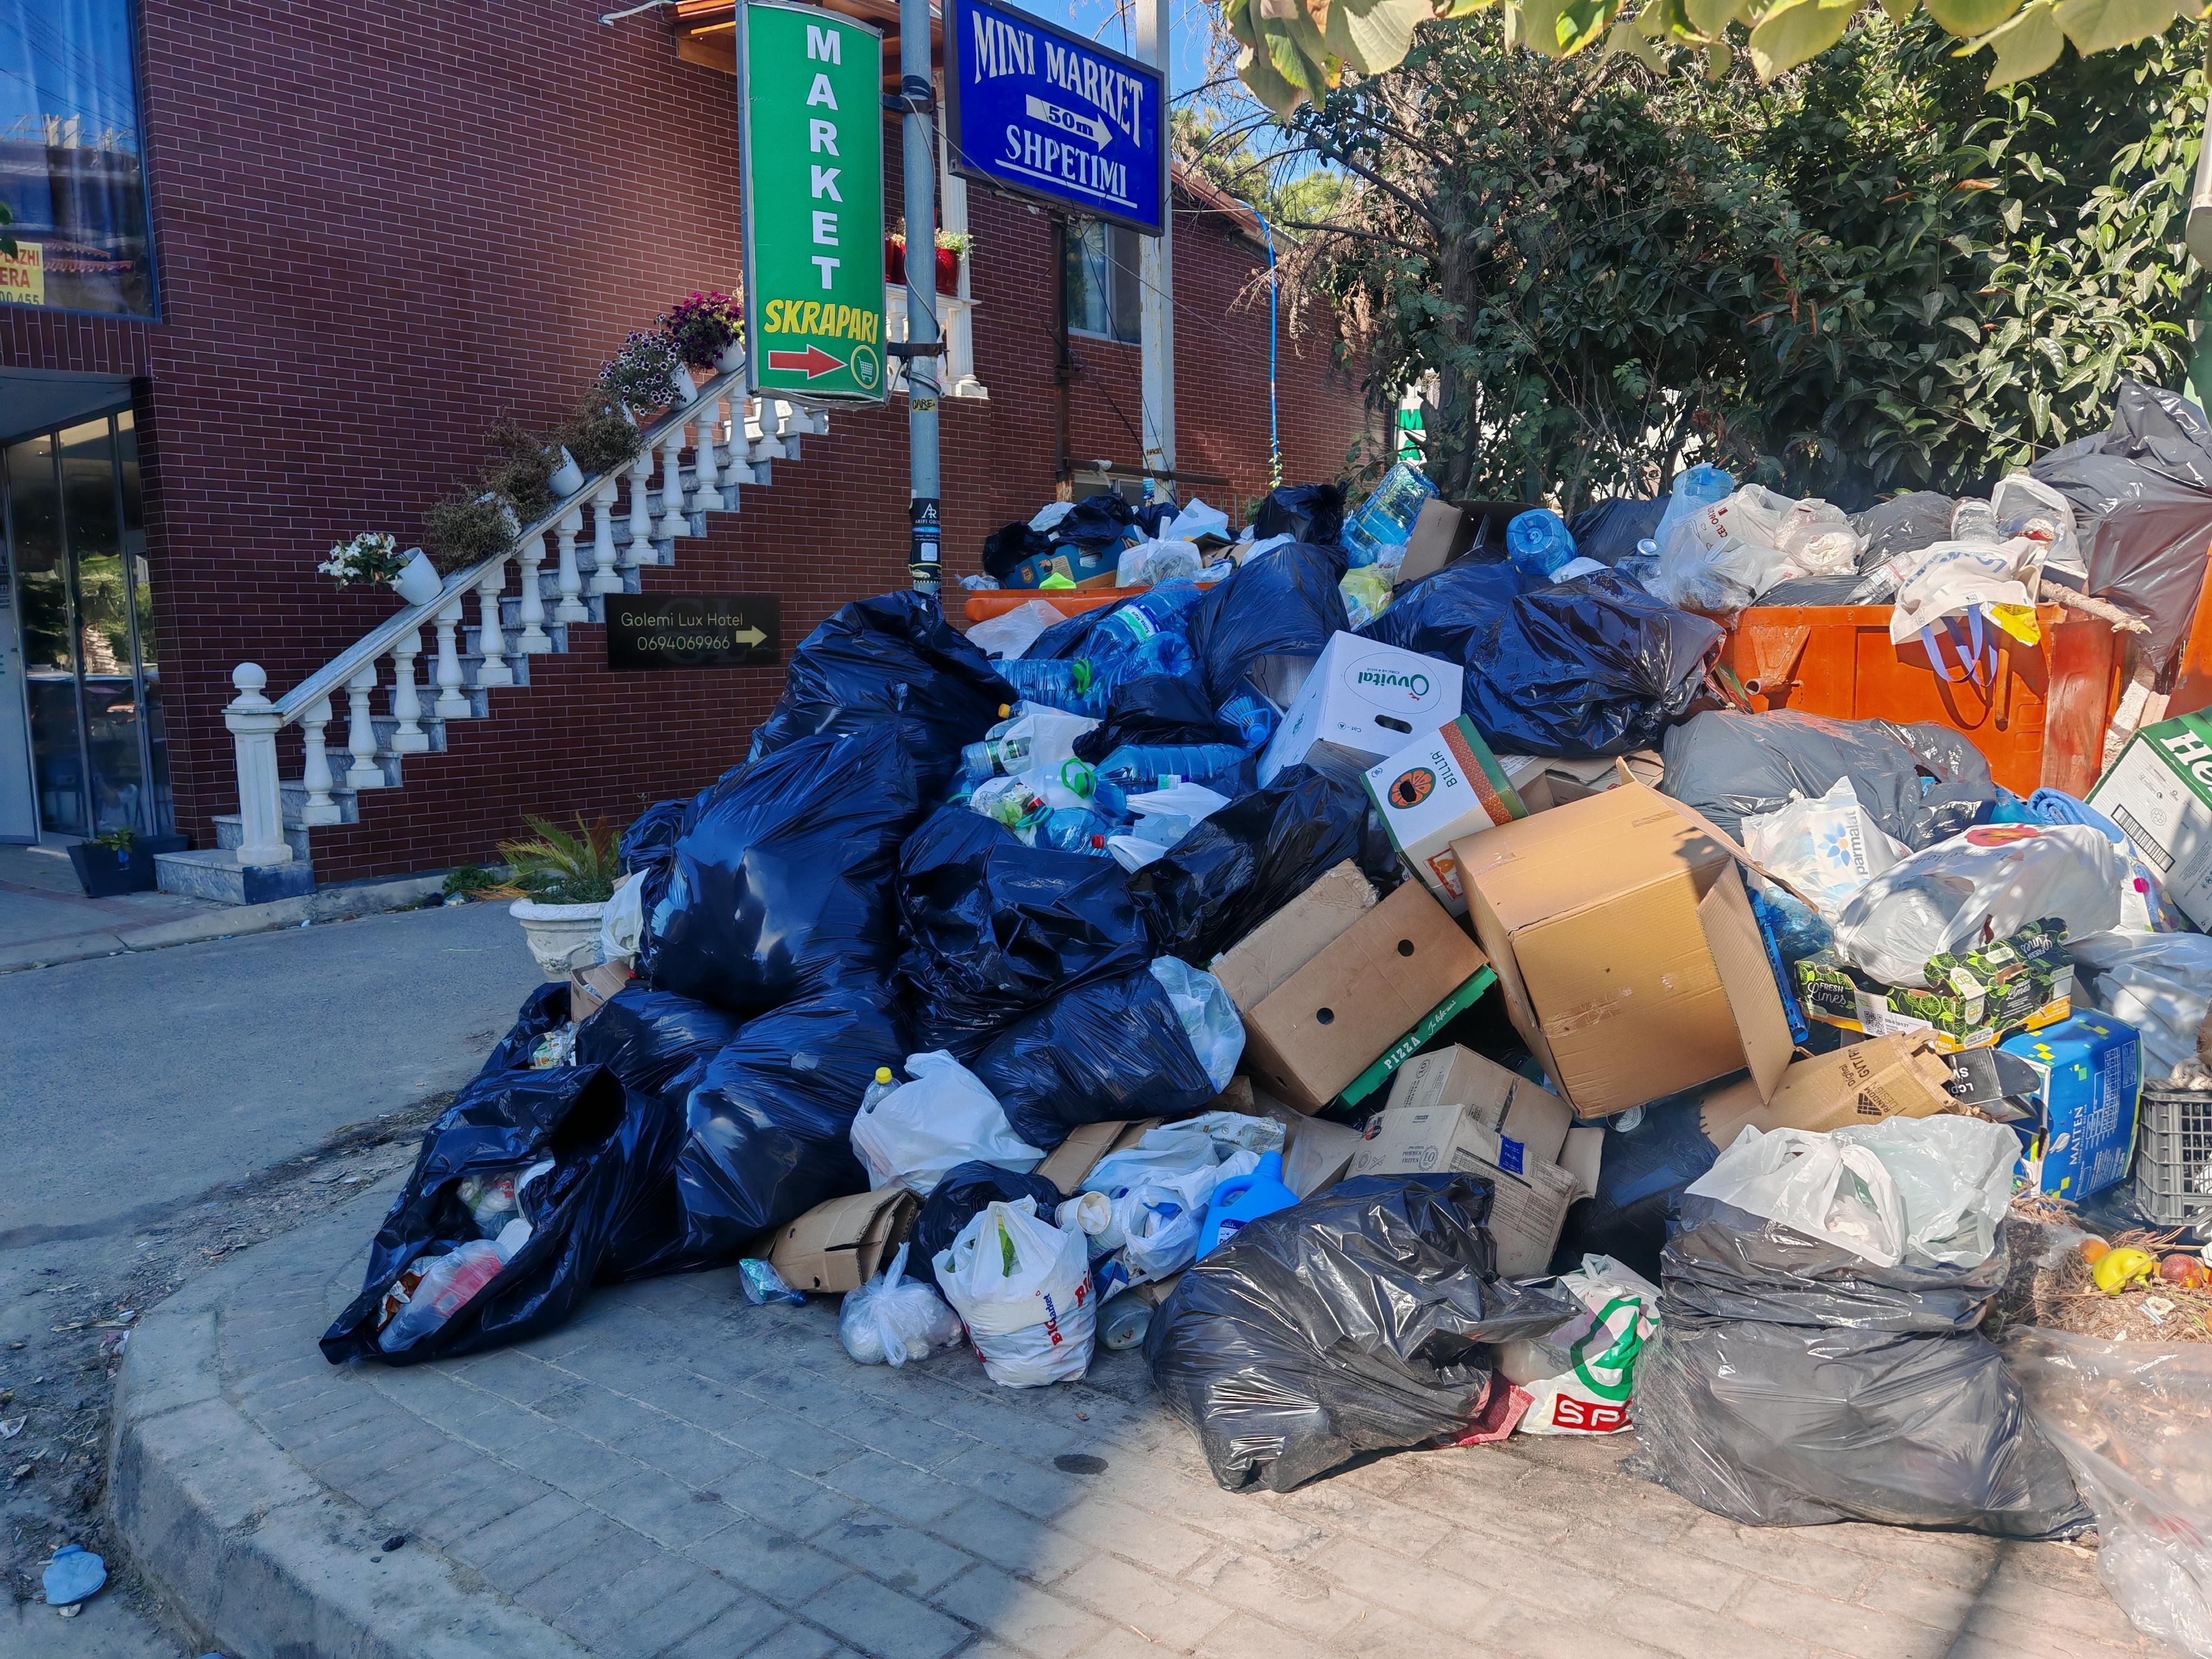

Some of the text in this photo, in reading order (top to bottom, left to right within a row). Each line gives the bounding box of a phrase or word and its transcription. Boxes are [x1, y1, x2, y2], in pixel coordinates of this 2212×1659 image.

[972, 10, 1143, 149] MINI MARKET
[1049, 106, 1094, 138] 50m
[806, 25, 843, 291] MARKET
[1006, 125, 1127, 199] SHPETIMI
[764, 299, 879, 346] SKRAPARI
[621, 612, 743, 626] Golemi Lux Hotel
[637, 636, 730, 651] 0694069966
[1358, 671, 1429, 696] Ovvital
[1432, 751, 1458, 788] BILLIA
[1845, 810, 1865, 875] parmalat
[1807, 982, 1847, 1005] Limes
[1819, 982, 1844, 993] FRESH
[1384, 1036, 1421, 1070] PIZZA
[1839, 1063, 1856, 1087] Digital
[1864, 1086, 1891, 1113] RANDOM
[1870, 1081, 1898, 1110] DESIGN
[2069, 1106, 2084, 1165] MAITEN
